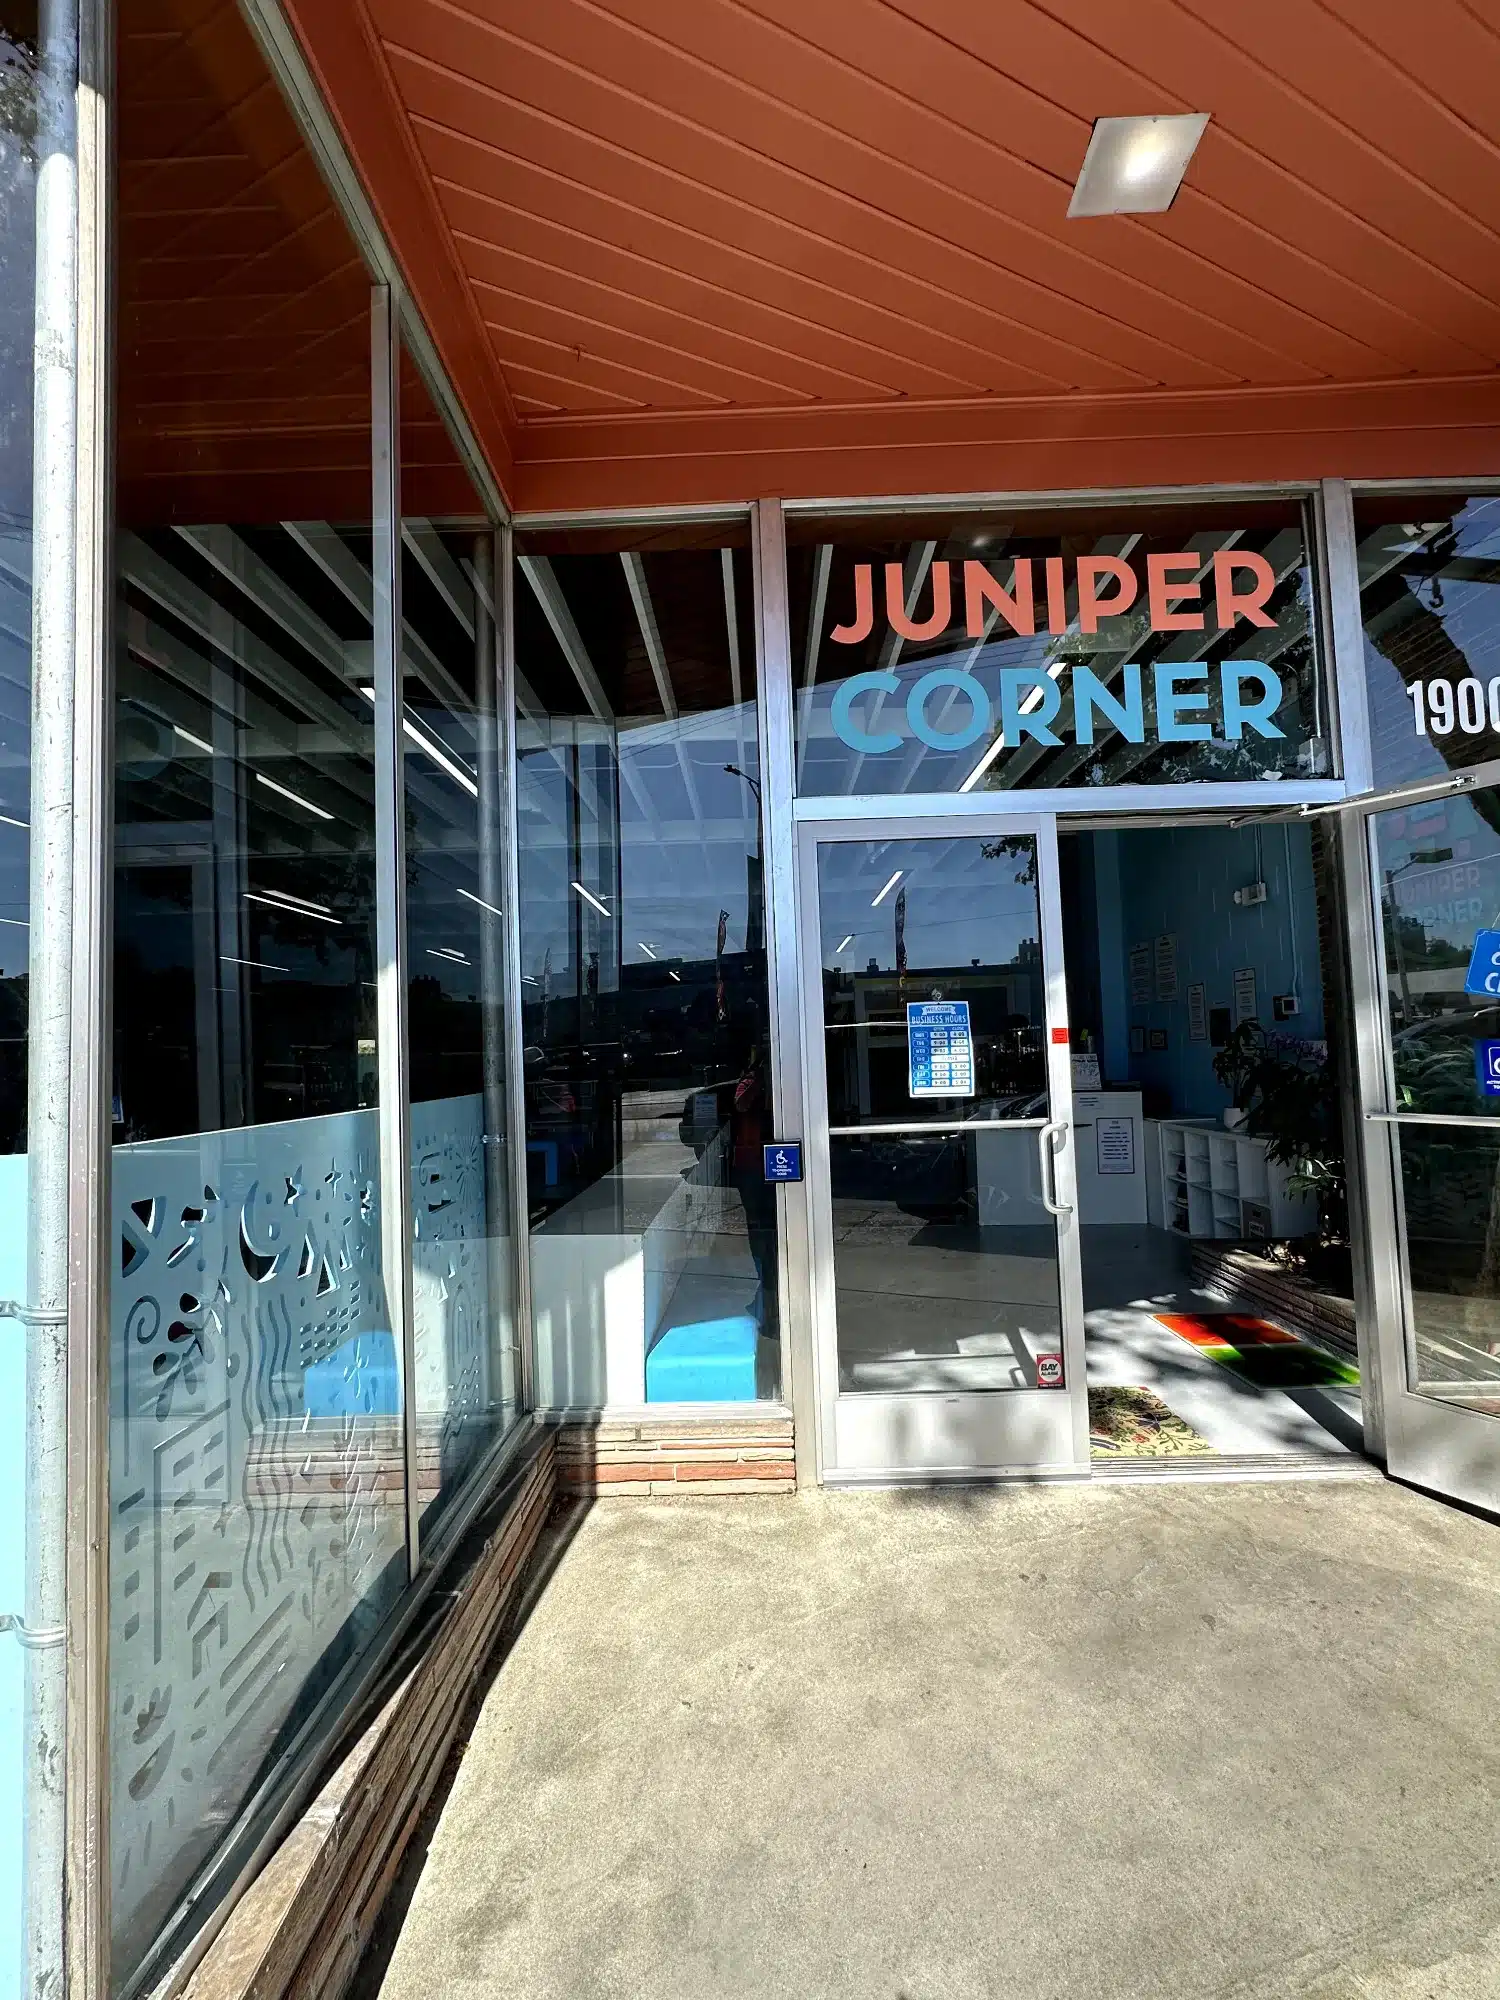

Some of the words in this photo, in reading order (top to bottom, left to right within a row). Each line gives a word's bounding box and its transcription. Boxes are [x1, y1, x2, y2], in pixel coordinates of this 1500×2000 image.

[830, 551, 1279, 644] JUNIPER
[830, 660, 1287, 754] CORNER
[912, 1015, 943, 1024] BUSINESS
[945, 1014, 967, 1023] HOURS
[1041, 1363, 1058, 1371] BAY
